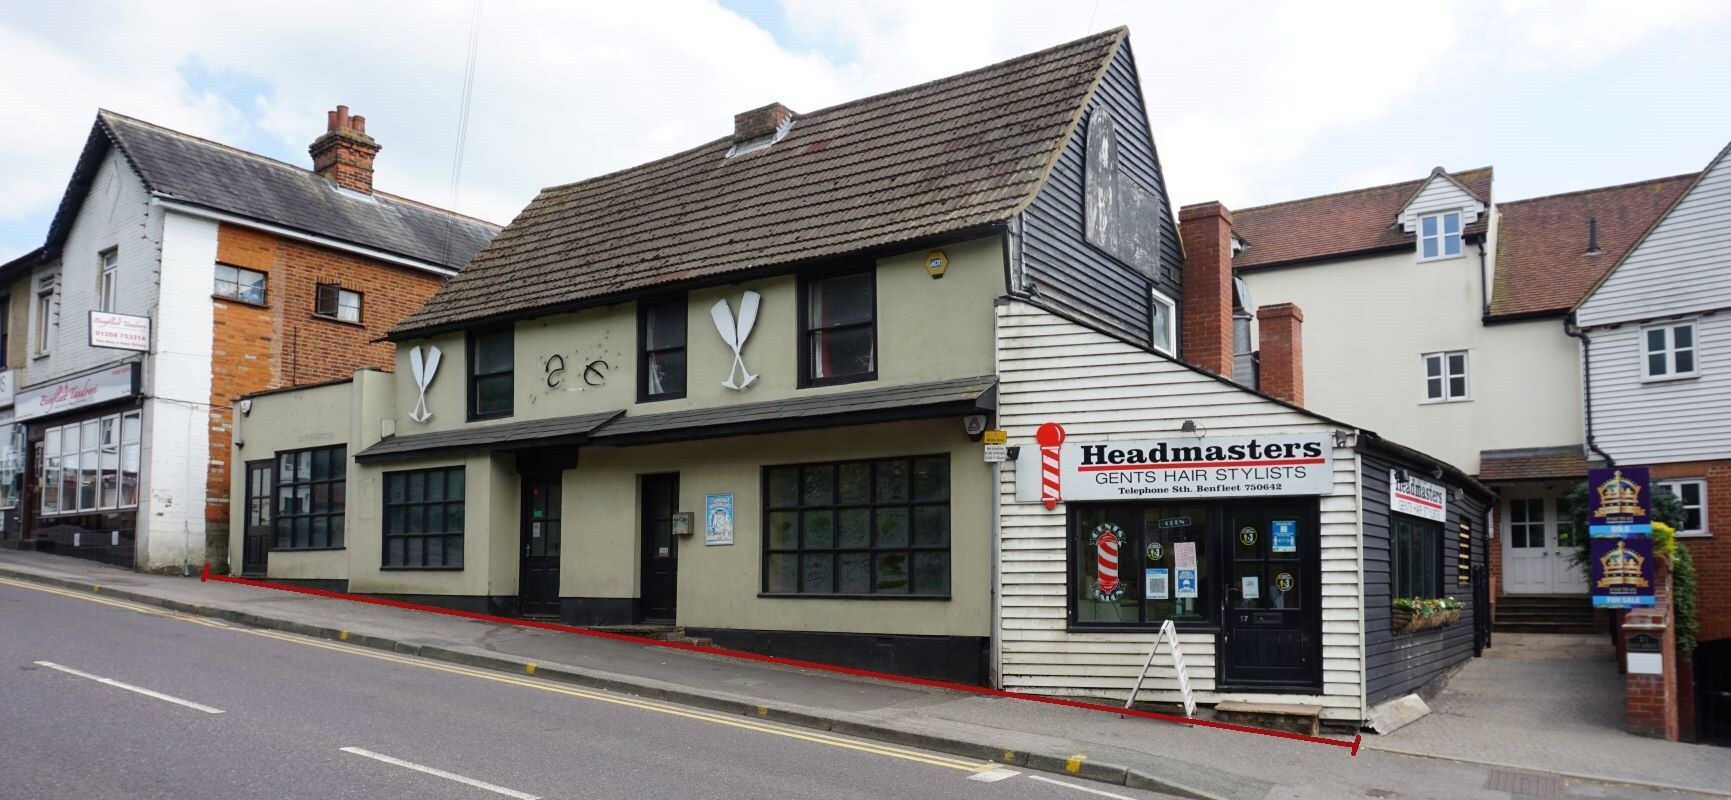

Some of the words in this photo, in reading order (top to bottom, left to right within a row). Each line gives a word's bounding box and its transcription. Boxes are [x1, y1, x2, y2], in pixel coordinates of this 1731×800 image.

[1080, 439, 1322, 465] Headmasters
[1095, 471, 1156, 485] GENTS
[1164, 469, 1207, 483] HAIR
[1216, 466, 1307, 481] STYLISTS
[1118, 485, 1169, 496] Telephone
[1172, 484, 1193, 493] Sth.
[1196, 483, 1241, 492] Benfleet
[1244, 483, 1282, 491] 750642
